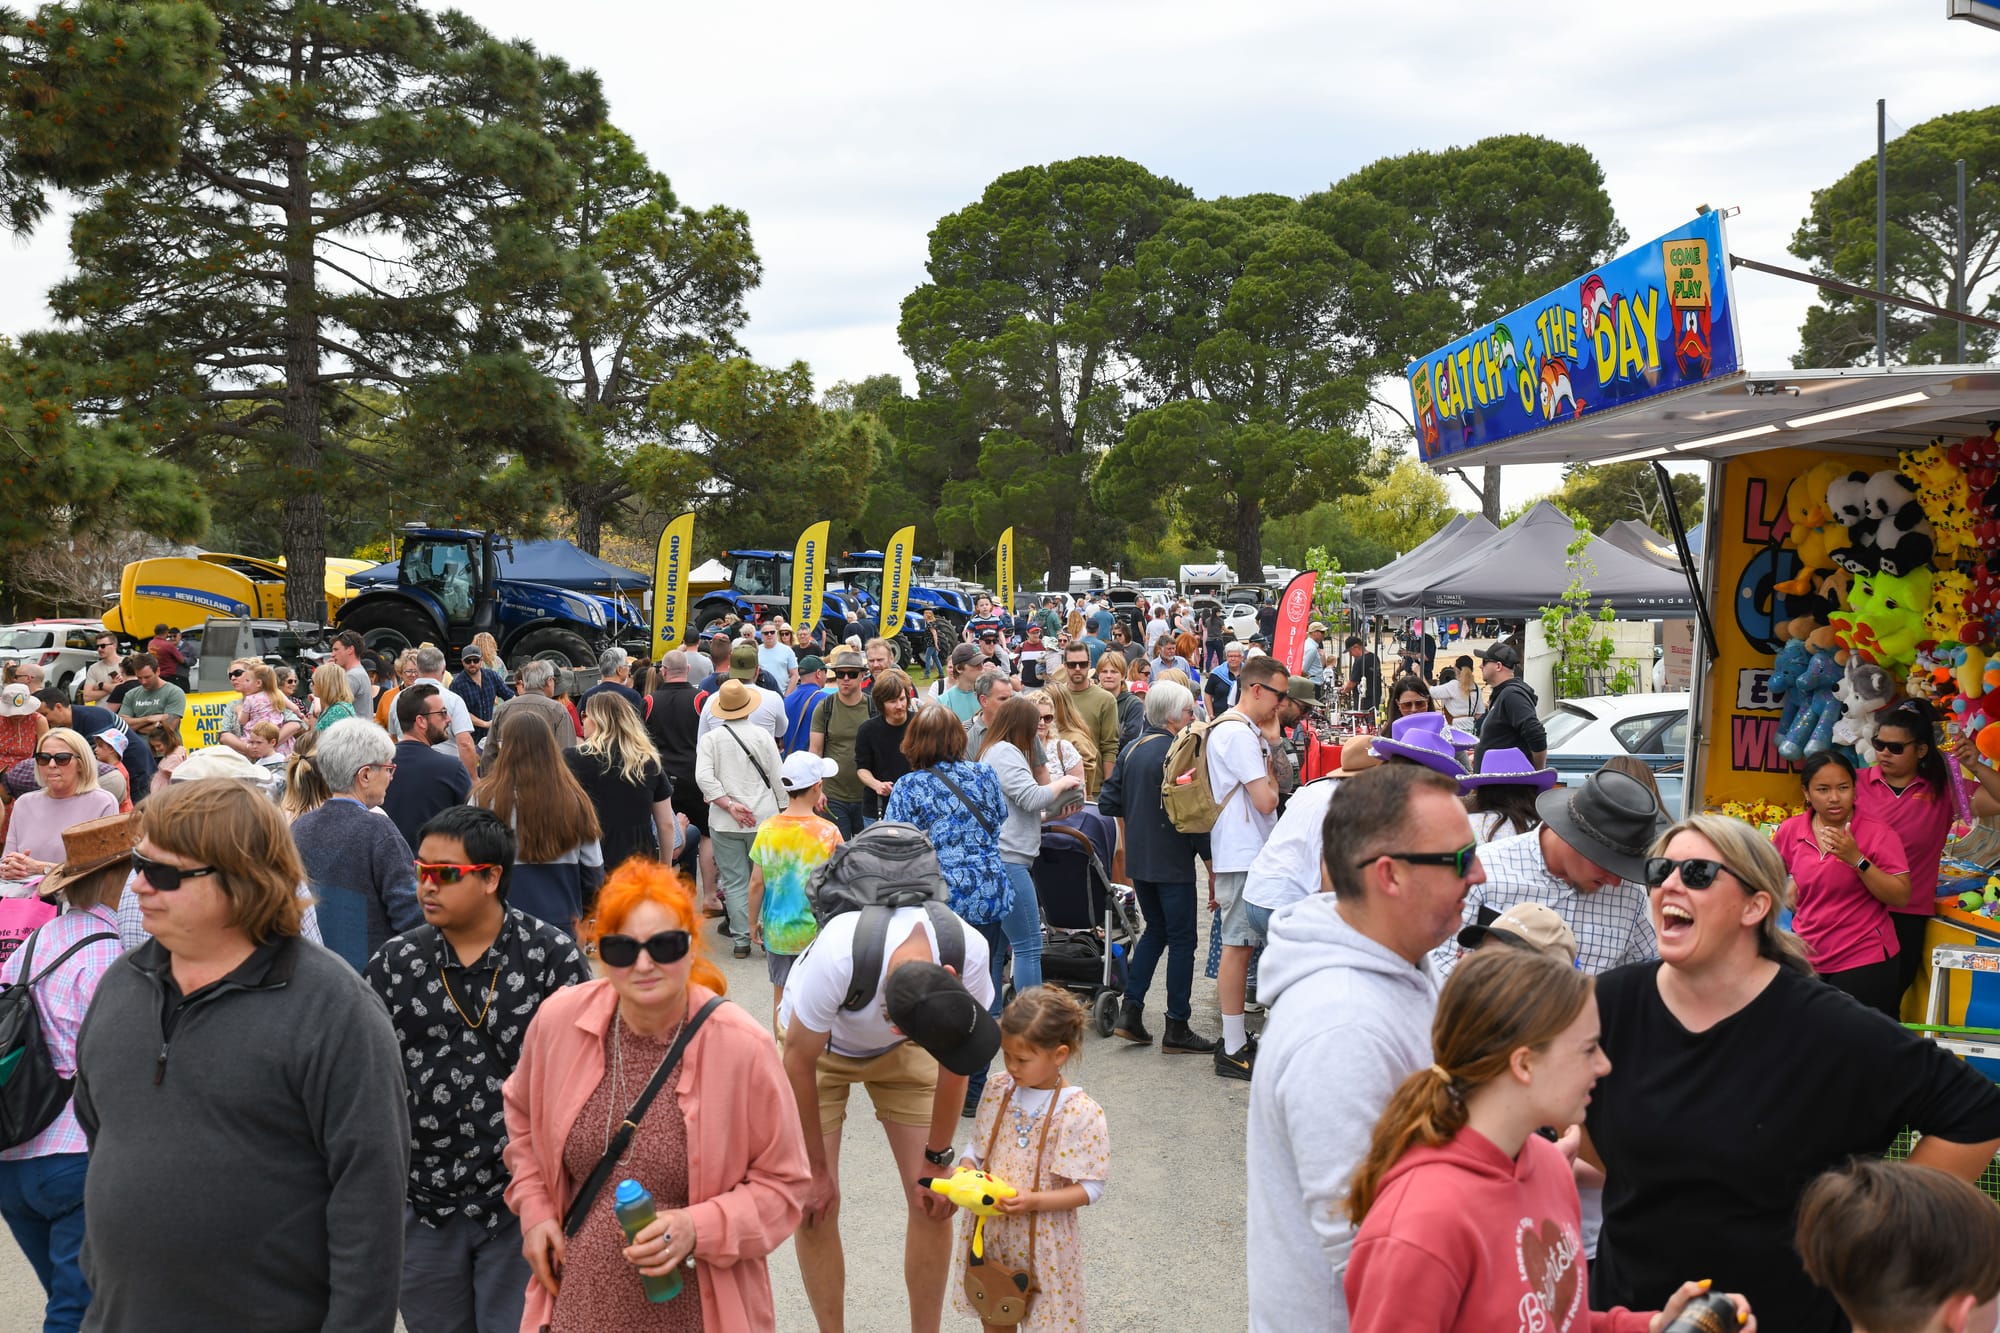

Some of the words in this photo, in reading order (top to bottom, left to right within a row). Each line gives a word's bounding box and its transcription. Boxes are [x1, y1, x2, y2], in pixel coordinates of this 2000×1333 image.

[1670, 246, 1701, 266] COME
[1680, 267, 1694, 280] AND
[1674, 280, 1702, 299] PLAY
[1434, 333, 1504, 420] CATCH
[1518, 337, 1538, 416] OF
[1536, 303, 1579, 364] THE
[1593, 285, 1662, 388] DAY
[668, 535, 680, 592] HOLLAND
[804, 540, 816, 592] HOLLAND
[893, 543, 903, 588] HOLLAND
[175, 591, 194, 601] NEW
[194, 596, 231, 612] HOLLAND
[666, 594, 676, 622] NEW
[802, 594, 812, 619] NEW
[890, 590, 901, 612] NEW
